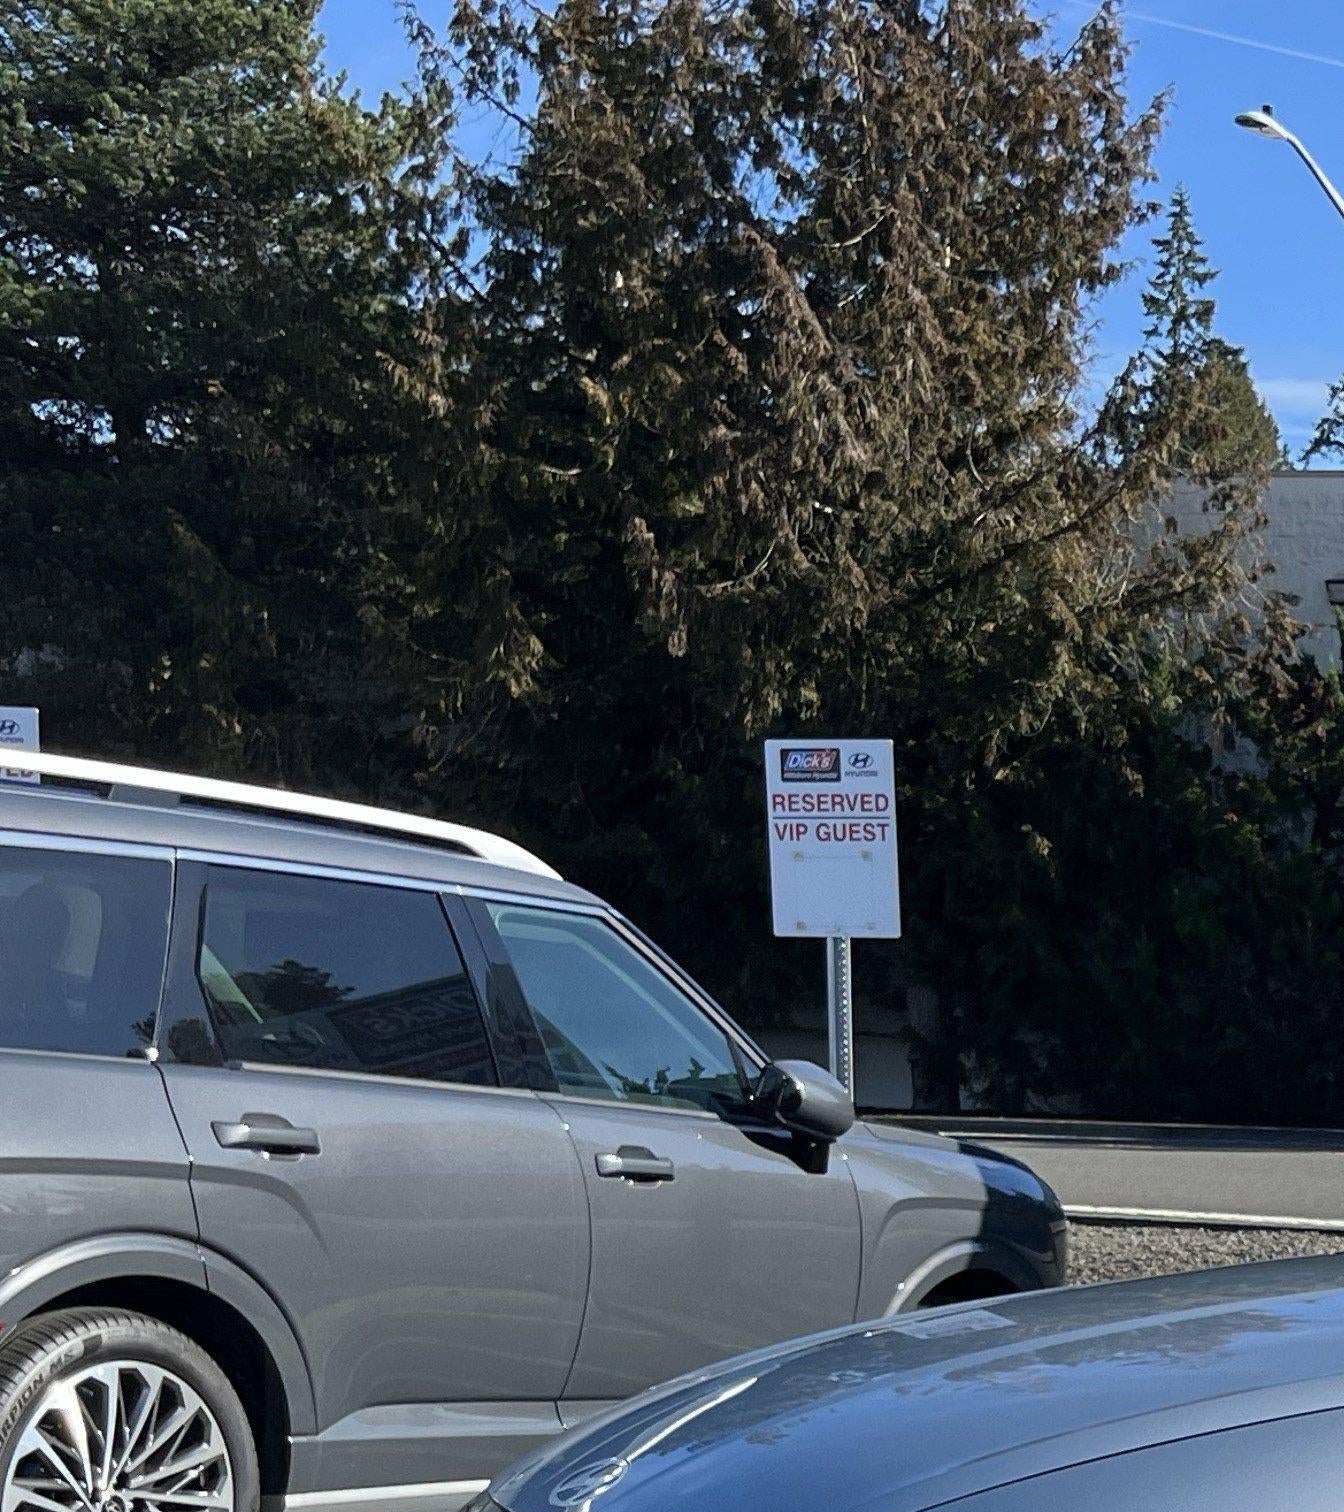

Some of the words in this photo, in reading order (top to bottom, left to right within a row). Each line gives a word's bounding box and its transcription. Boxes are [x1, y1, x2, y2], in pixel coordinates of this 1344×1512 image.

[772, 793, 889, 812] RESERVED
[774, 822, 808, 842] VIP
[815, 822, 889, 842] GUEST
